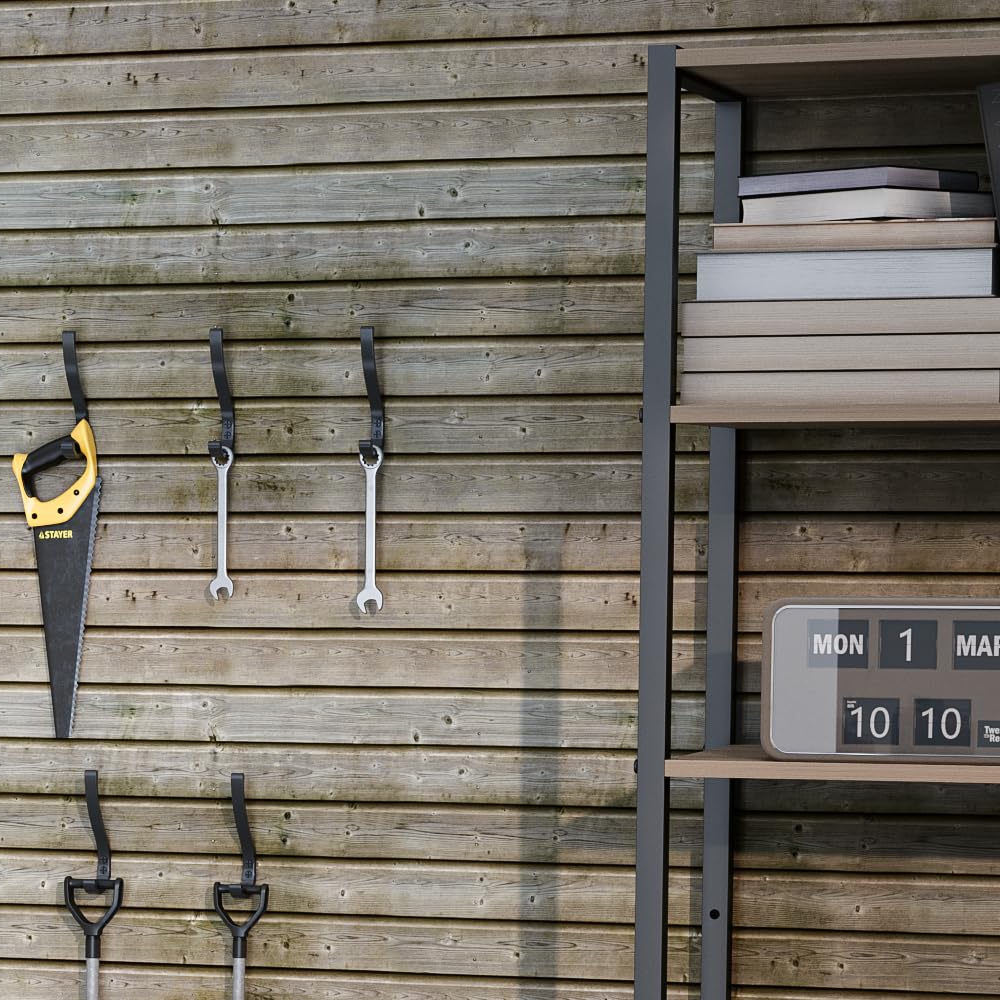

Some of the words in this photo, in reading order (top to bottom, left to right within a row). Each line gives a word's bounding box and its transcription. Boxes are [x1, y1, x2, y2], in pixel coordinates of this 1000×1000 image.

[44, 530, 73, 539] STAYER
[813, 633, 864, 655] MON
[899, 628, 912, 662] 1
[850, 706, 890, 739] 10
[921, 707, 961, 740] 10
